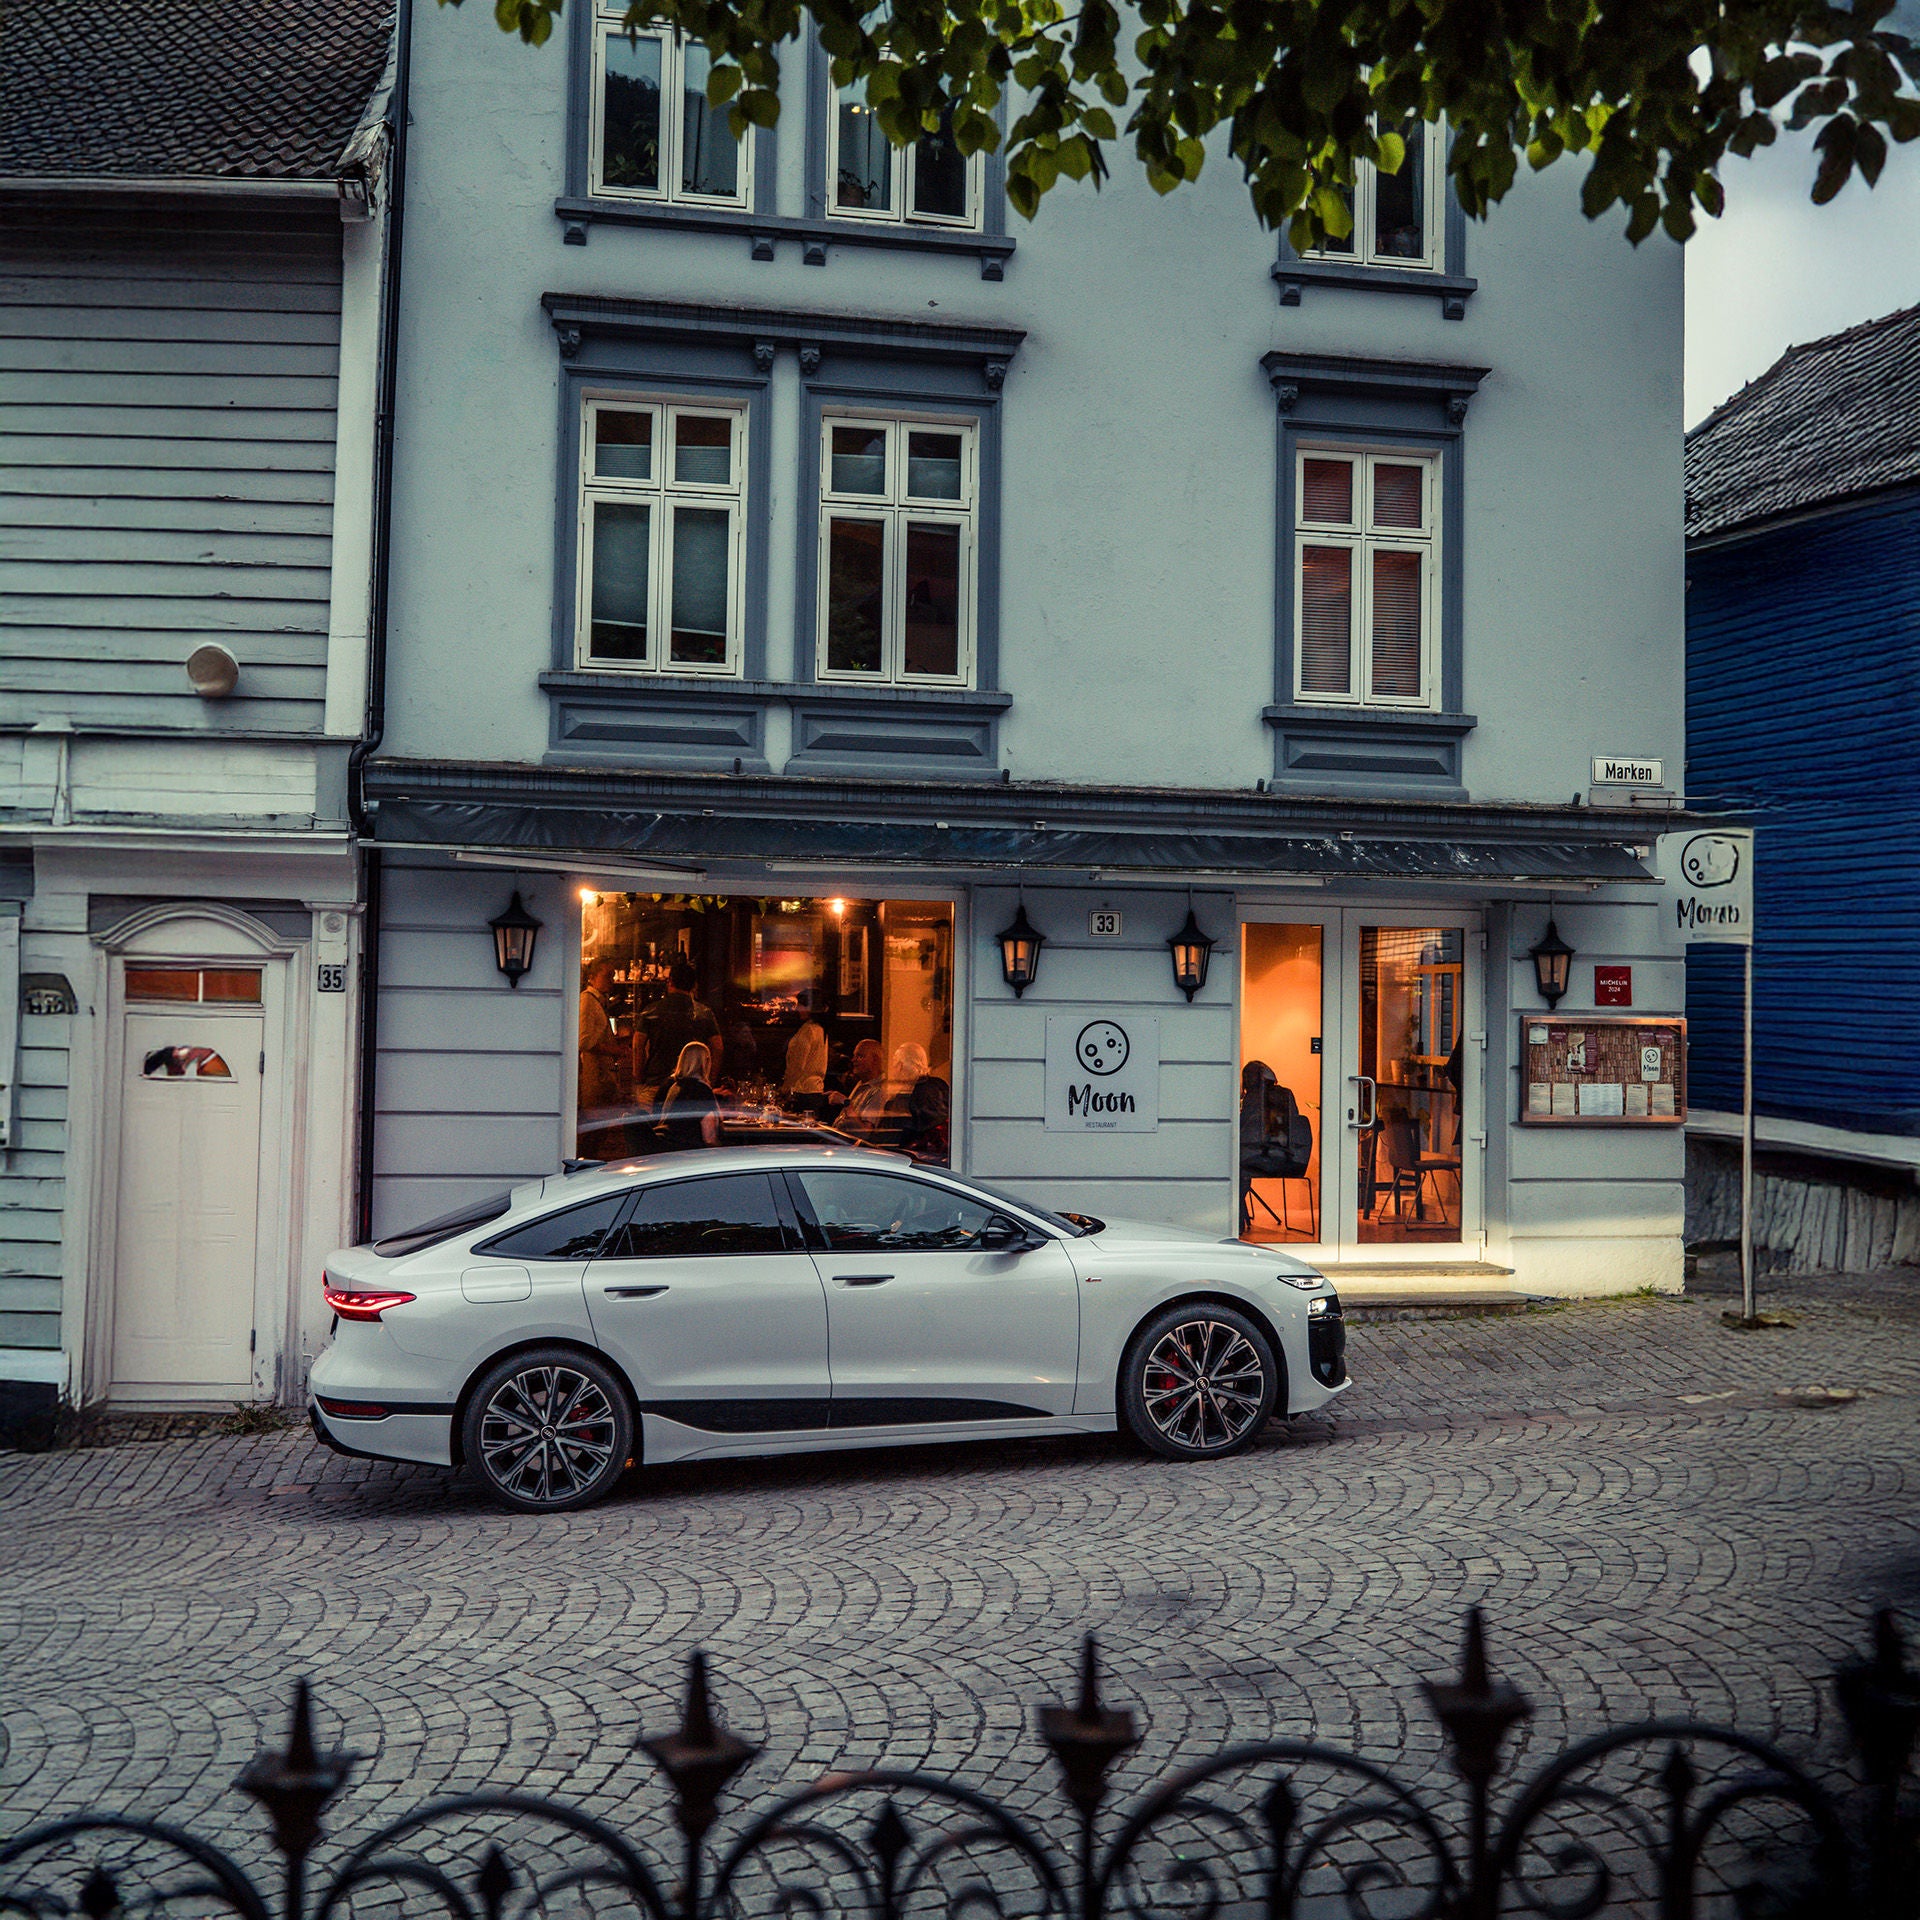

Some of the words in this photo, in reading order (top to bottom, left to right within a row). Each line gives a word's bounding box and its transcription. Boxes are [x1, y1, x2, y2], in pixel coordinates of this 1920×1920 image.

[1605, 762, 1652, 781] Marken
[1096, 914, 1115, 933] 33
[323, 969, 342, 989] 35
[1068, 1083, 1135, 1117] Moon
[1084, 1121, 1117, 1129] RESTAURANT
